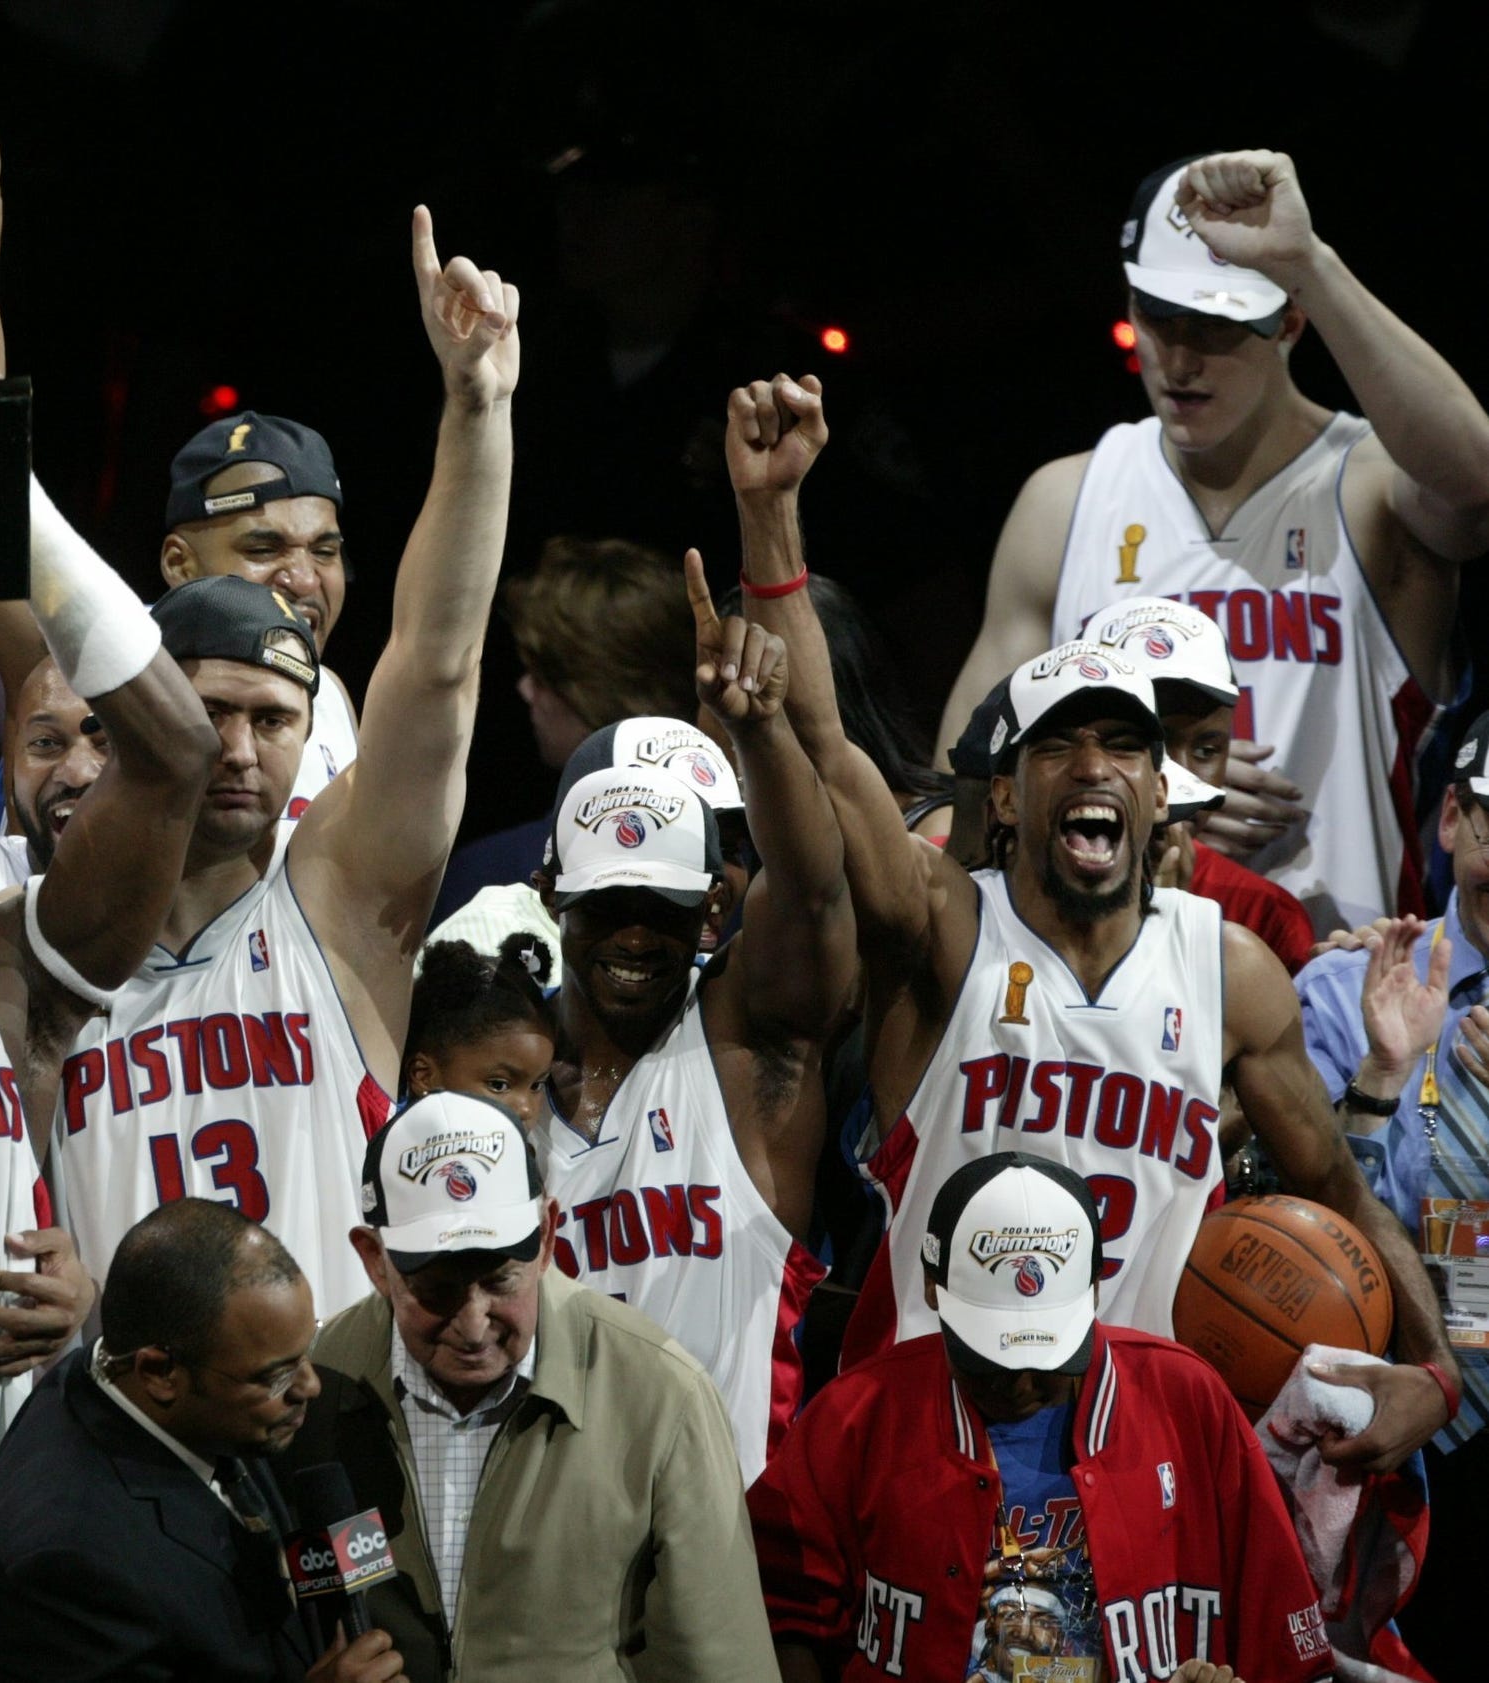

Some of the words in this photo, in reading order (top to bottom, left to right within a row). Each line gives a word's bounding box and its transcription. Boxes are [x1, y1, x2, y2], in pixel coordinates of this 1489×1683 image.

[575, 795, 685, 830] CHAMPIONS
[63, 1011, 313, 1136] PISTONS
[960, 1052, 1218, 1181] PISTONS
[149, 1118, 270, 1224] 13
[399, 1132, 504, 1182] CHAMPIONS
[969, 1229, 1080, 1266] CHAMPIONS
[1001, 1227, 1029, 1235] 2004
[1033, 1226, 1053, 1234] NBA
[1236, 1243, 1320, 1322] NBA
[1010, 1333, 1035, 1343] LOCKER
[1036, 1333, 1054, 1342] ROOM
[300, 1547, 336, 1572] abc
[347, 1531, 387, 1560] abc
[296, 1574, 342, 1593] SPORTS
[343, 1555, 393, 1583] SPORTS
